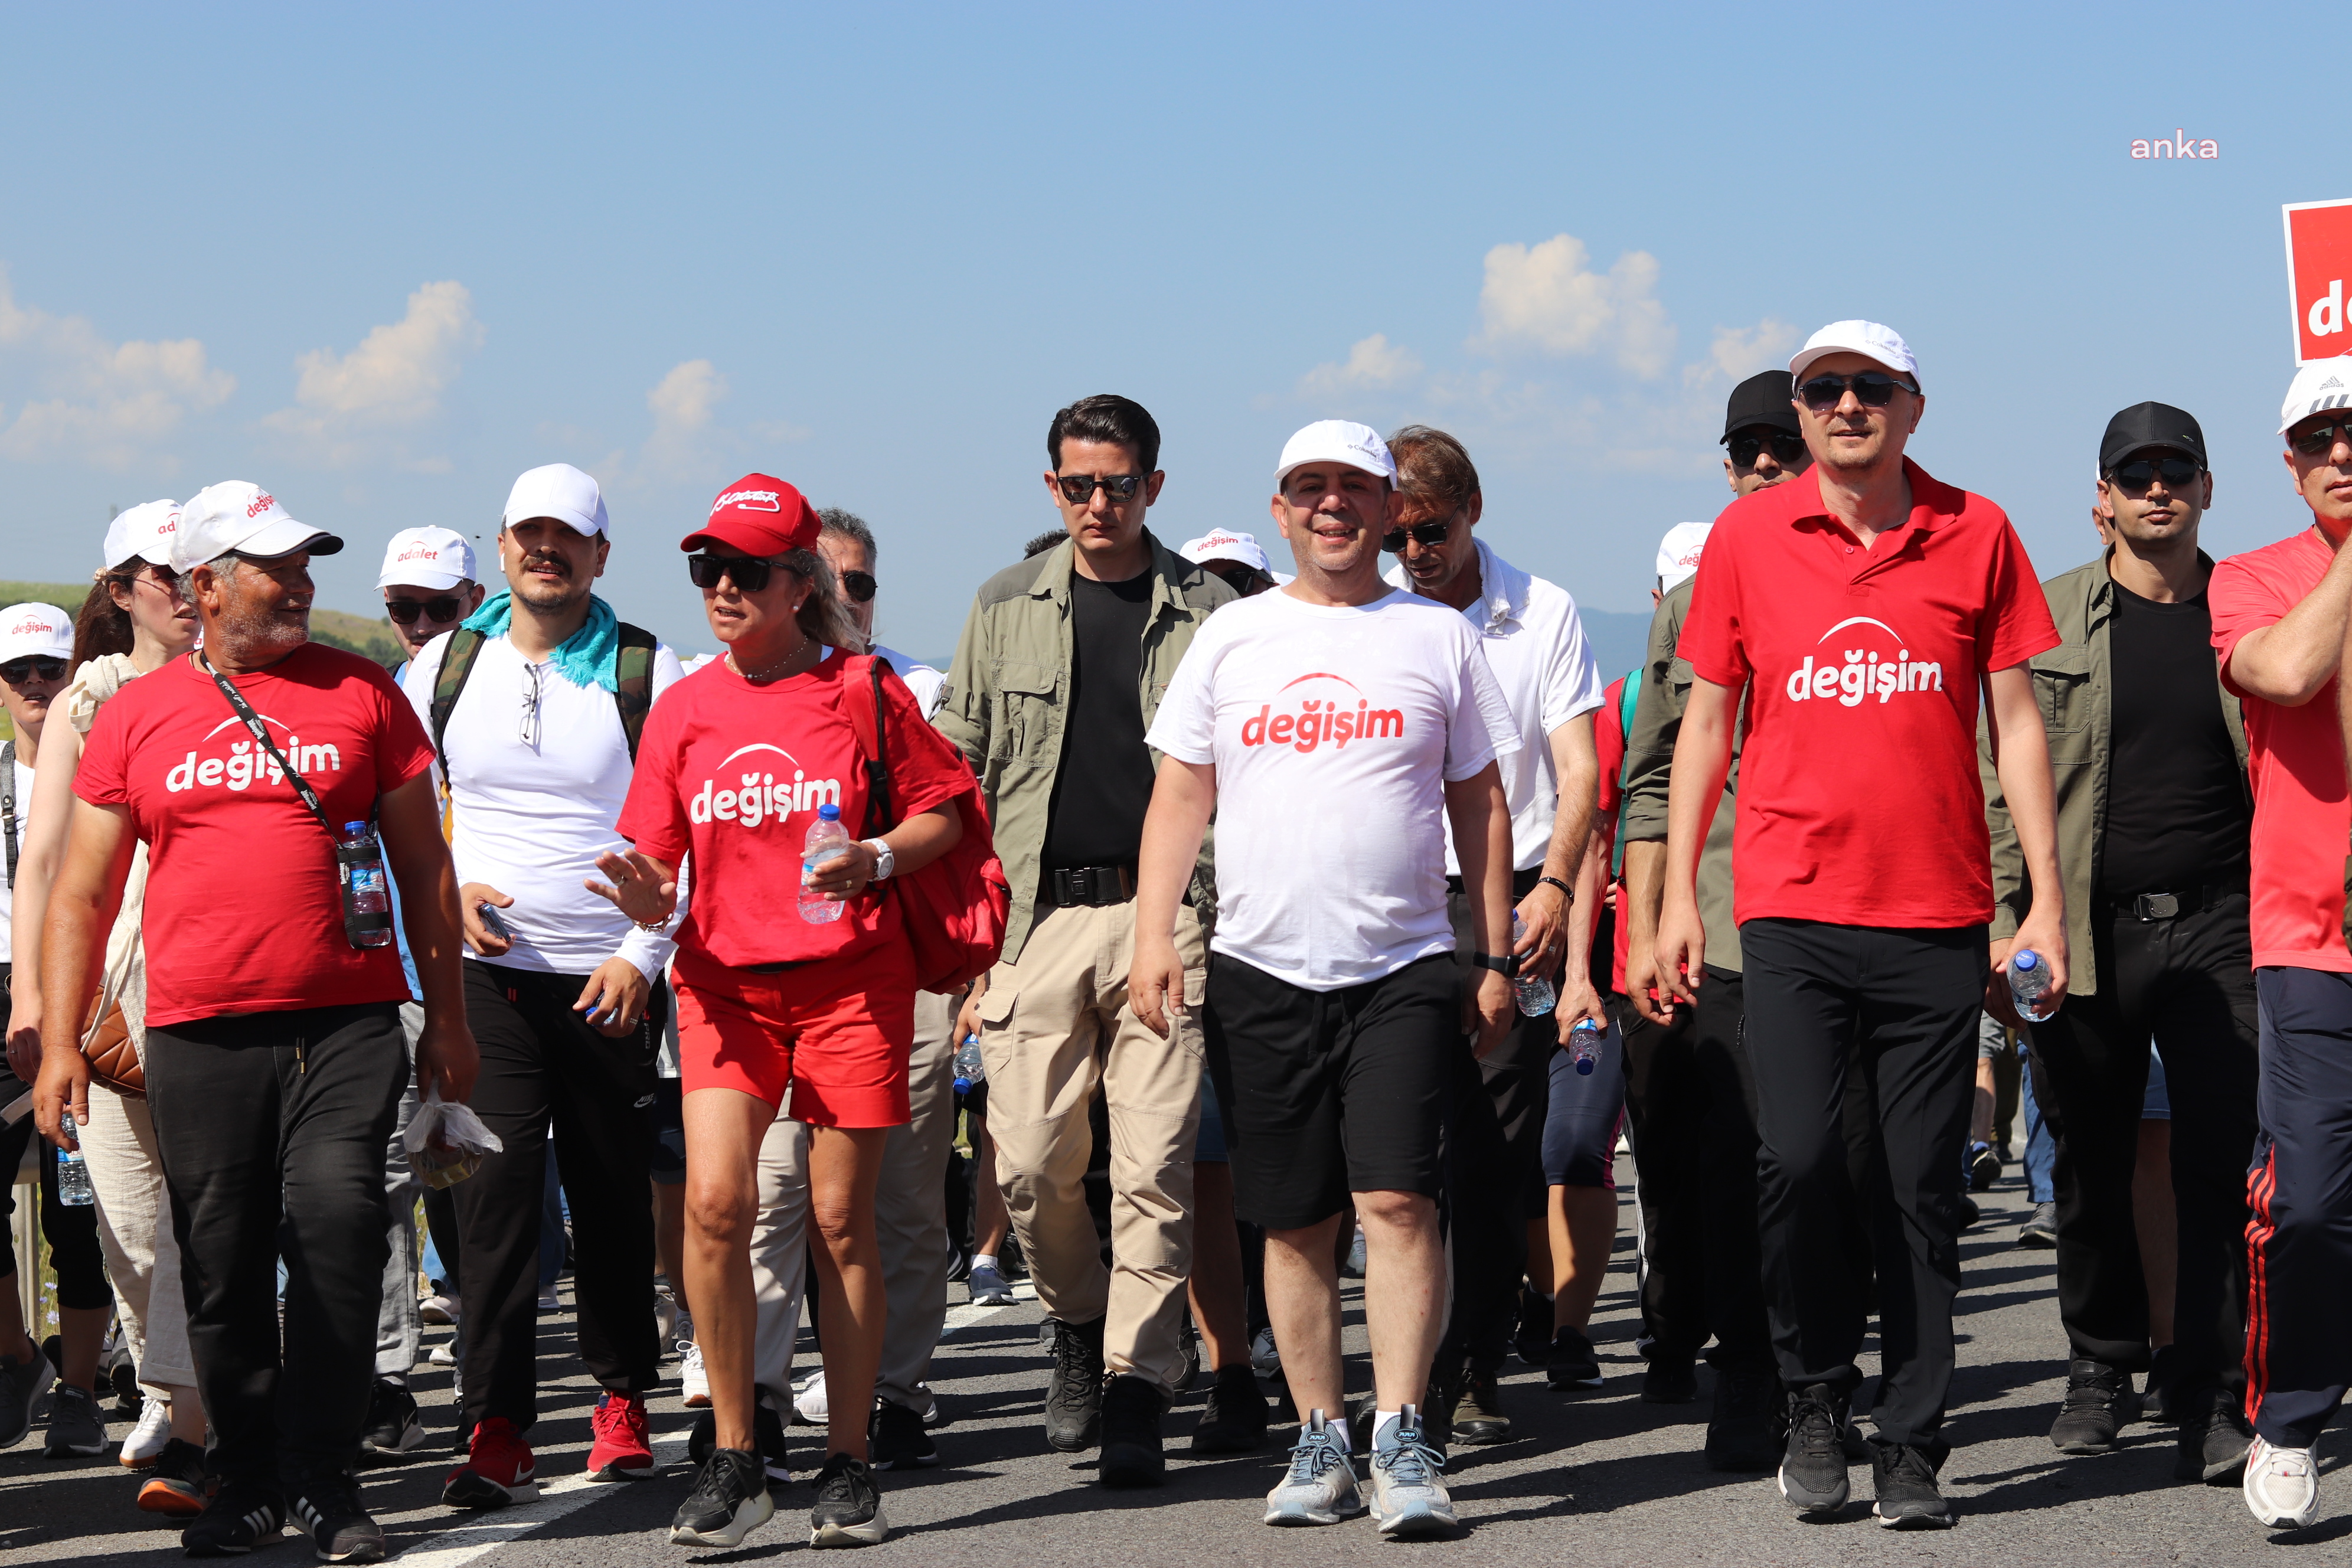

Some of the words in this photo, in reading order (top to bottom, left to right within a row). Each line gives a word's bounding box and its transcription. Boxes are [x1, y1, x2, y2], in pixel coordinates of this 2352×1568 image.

[1872, 341, 1897, 354] Columbia
[1197, 536, 1239, 551] değişim
[398, 548, 438, 561] adalet
[1678, 553, 1701, 567] değ
[12, 621, 52, 635] değişim
[1786, 649, 1942, 707] değişim
[1242, 699, 1403, 753] değişim
[166, 736, 340, 792] değişim
[690, 769, 841, 827] değişim
[639, 1093, 654, 1102] NIKE
